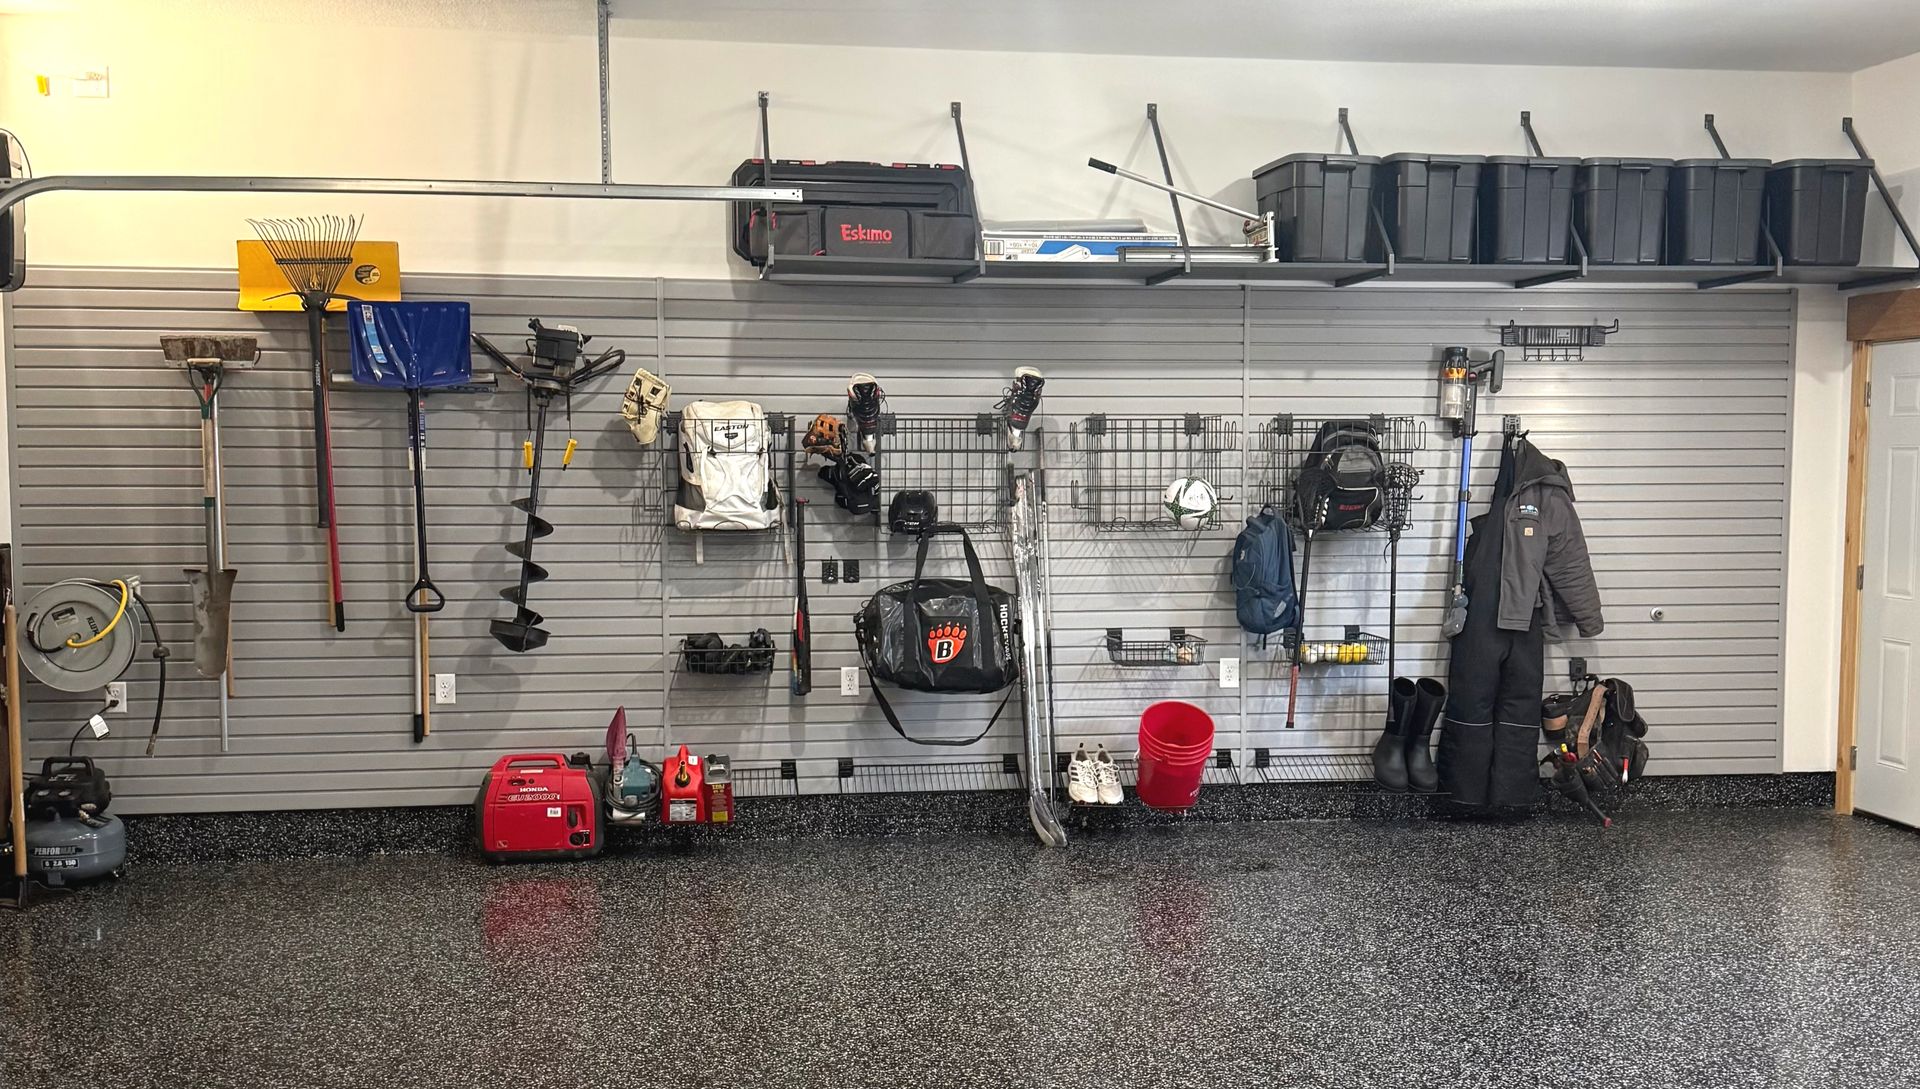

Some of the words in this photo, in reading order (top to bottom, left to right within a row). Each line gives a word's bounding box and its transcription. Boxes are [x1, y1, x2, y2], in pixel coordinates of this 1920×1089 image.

[840, 224, 893, 241] Eskimo
[714, 424, 749, 432] EASTON
[935, 639, 954, 661] B
[34, 846, 77, 856] PERFORMAX
